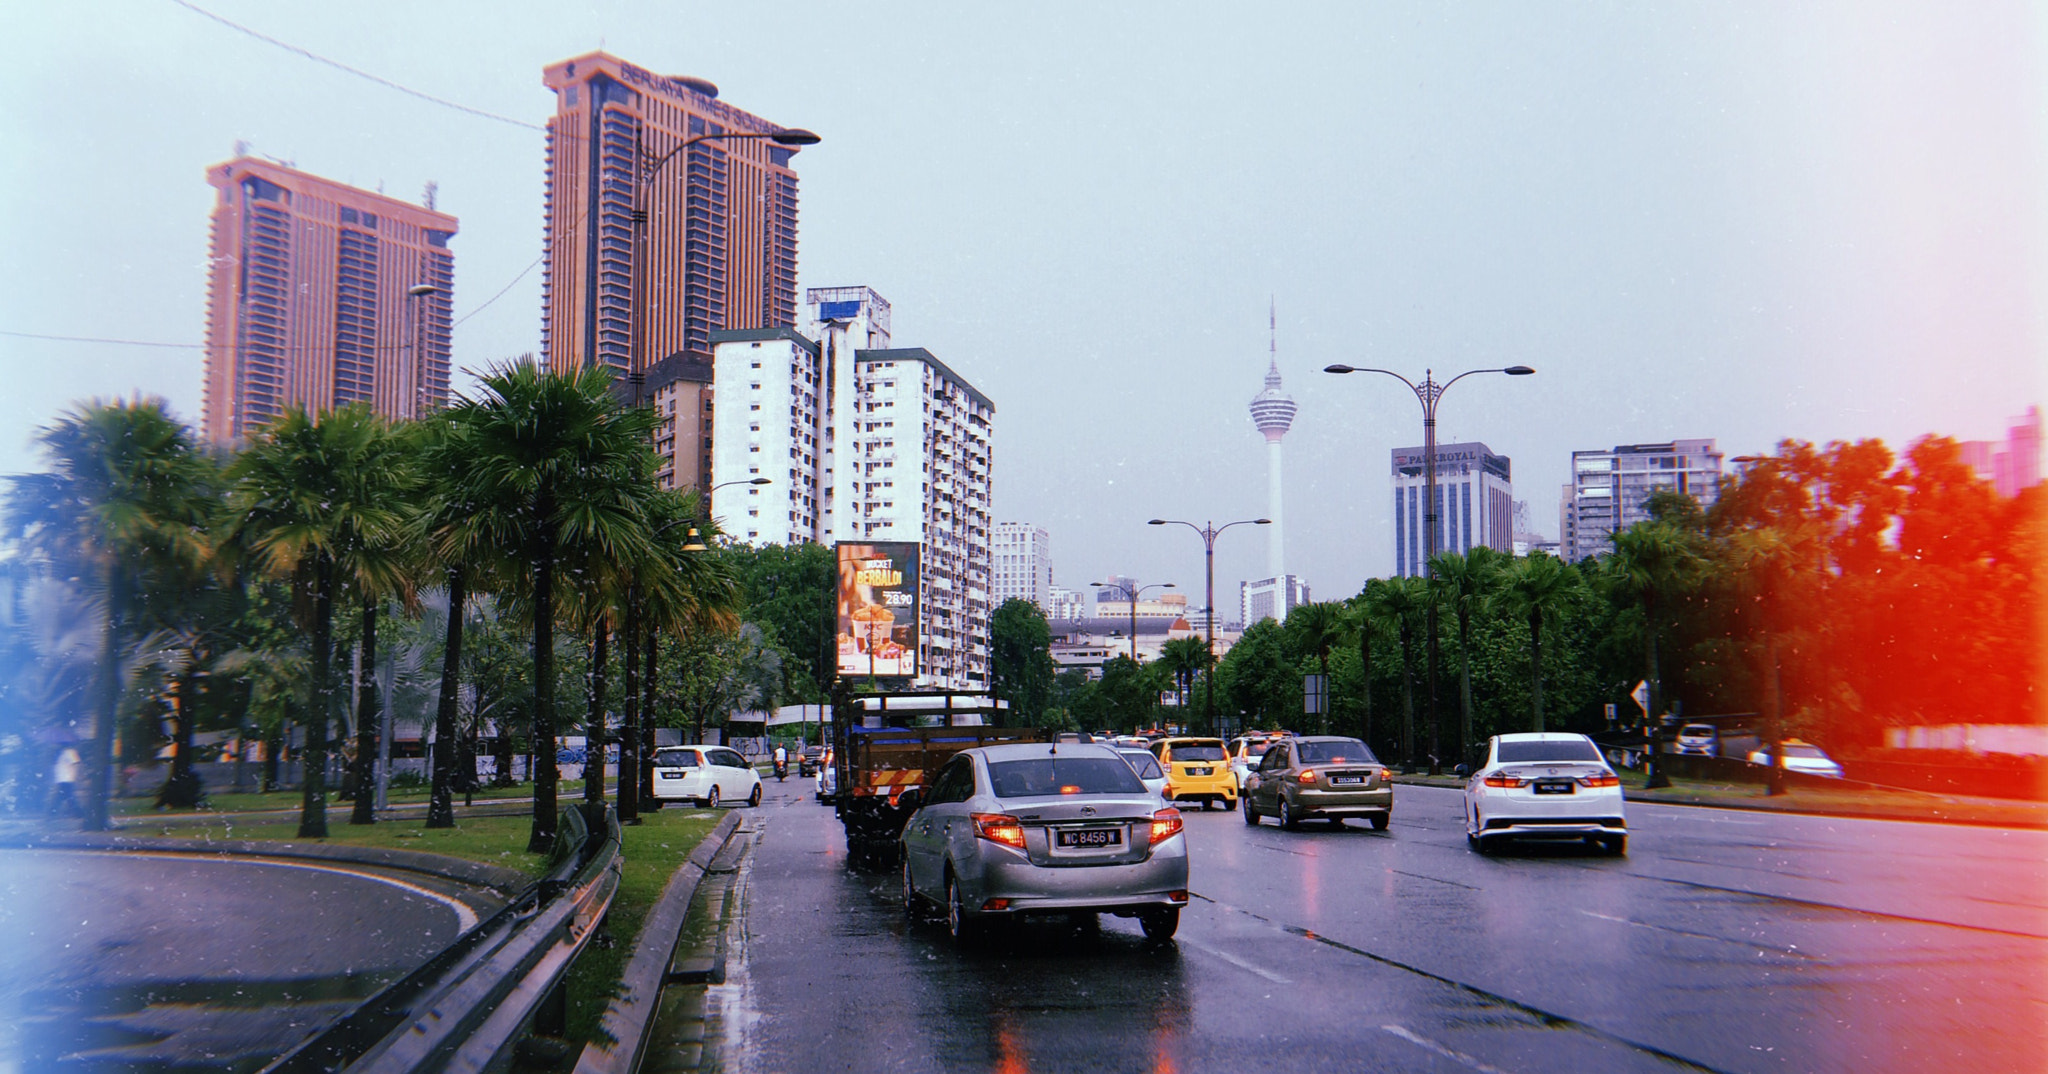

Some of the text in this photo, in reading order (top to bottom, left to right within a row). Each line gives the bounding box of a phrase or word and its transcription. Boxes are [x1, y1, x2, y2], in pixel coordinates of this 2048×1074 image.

[620, 61, 686, 102] BERJAYA
[688, 88, 730, 122] TIMES
[1409, 451, 1477, 464] PAKROYAL
[866, 559, 893, 569] BUCKET
[856, 569, 902, 587] BERBALOI
[885, 594, 913, 605] 28.90
[1063, 831, 1116, 844] WC 8456 W
